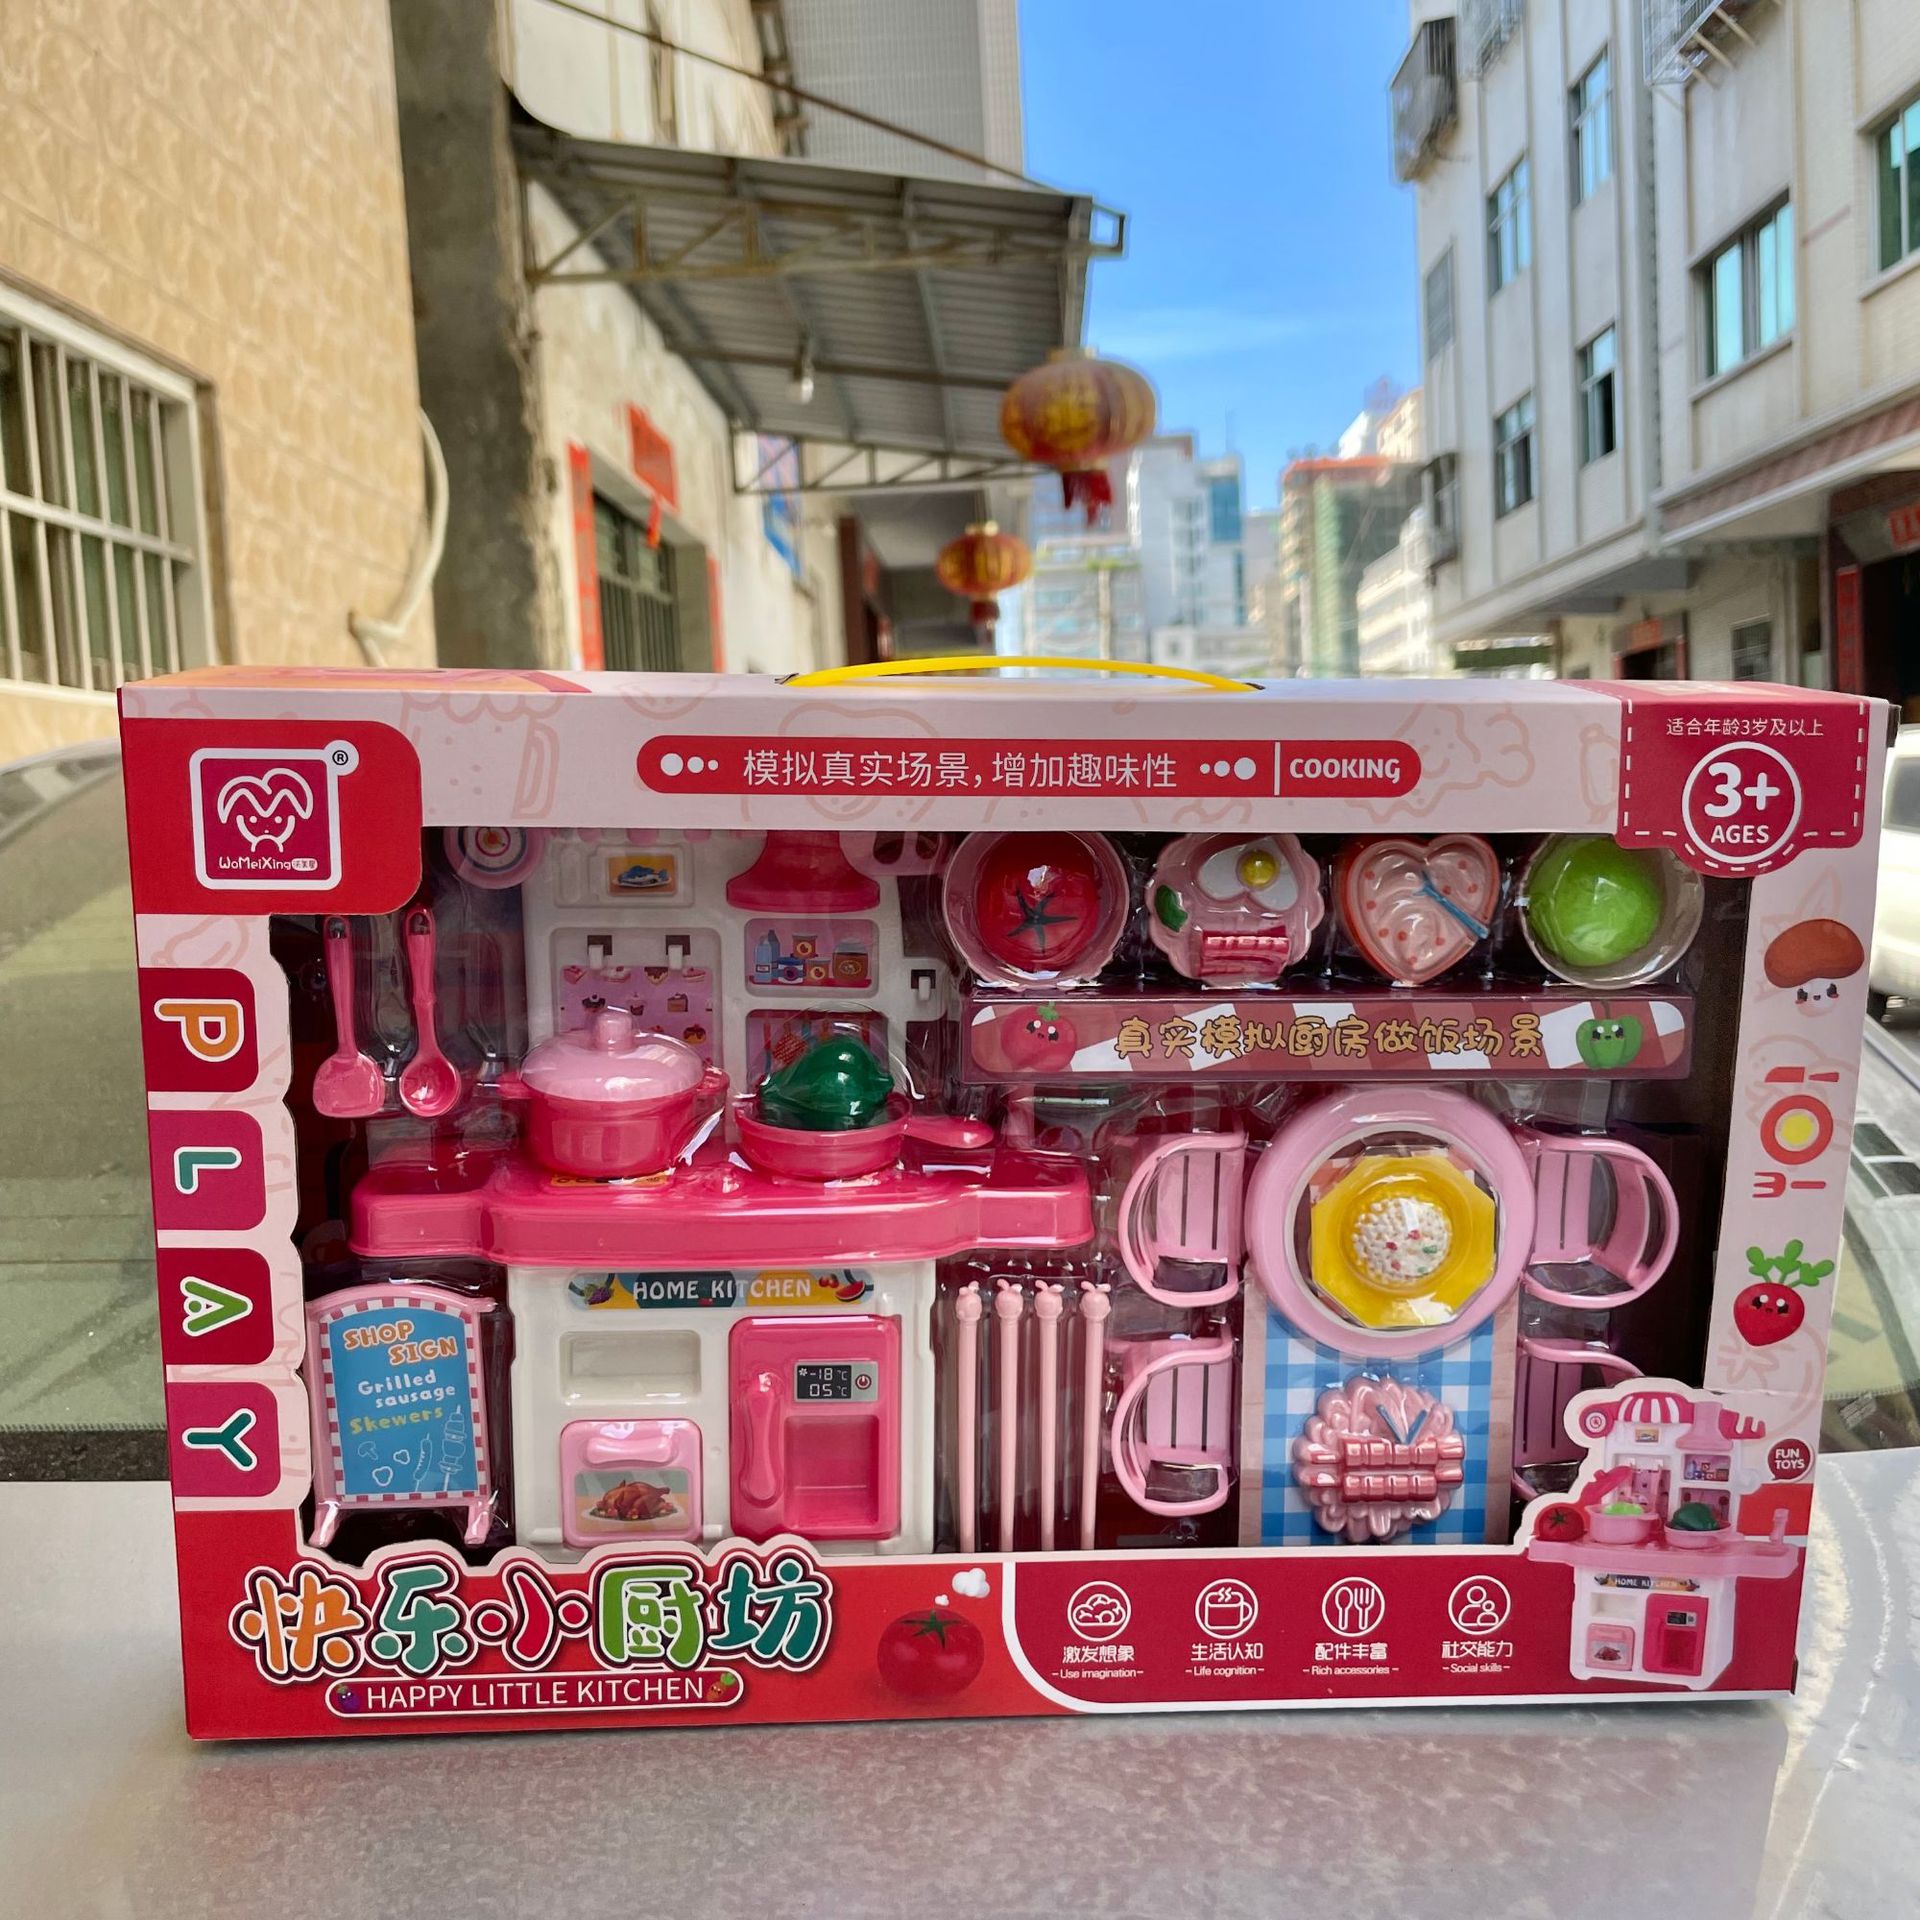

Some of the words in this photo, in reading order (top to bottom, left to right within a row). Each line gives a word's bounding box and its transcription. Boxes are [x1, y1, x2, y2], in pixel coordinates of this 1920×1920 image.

[1667, 718, 1824, 737] 适合年龄3岁及以上
[1289, 757, 1401, 785] COOKING
[1703, 761, 1781, 818] 3+
[1710, 824, 1770, 844] AGES
[218, 856, 292, 871] WoMeiXing
[1113, 1012, 1547, 1060] 真实模拟厨房做饭场景
[154, 998, 257, 1472] PLAY
[633, 1280, 700, 1300] HOME
[710, 1278, 812, 1299] KITCHEN
[342, 1319, 414, 1350] SHOP
[388, 1336, 458, 1366] SIGN
[358, 1369, 437, 1396] Grilled
[375, 1385, 456, 1409] sausage
[350, 1407, 444, 1434] Skewers
[1775, 1448, 1800, 1461] FUN
[1775, 1459, 1806, 1471] TOYS
[236, 1554, 826, 1677] 快乐小厨坊
[1062, 1644, 1135, 1664] 激发想象
[1190, 1642, 1264, 1662] 生活认知
[1314, 1641, 1388, 1661] 配件丰富
[1441, 1640, 1514, 1660] 社交能力
[366, 1682, 462, 1708] HAPPY
[471, 1679, 571, 1706] LITTLE
[576, 1676, 704, 1703] KITCHEN
